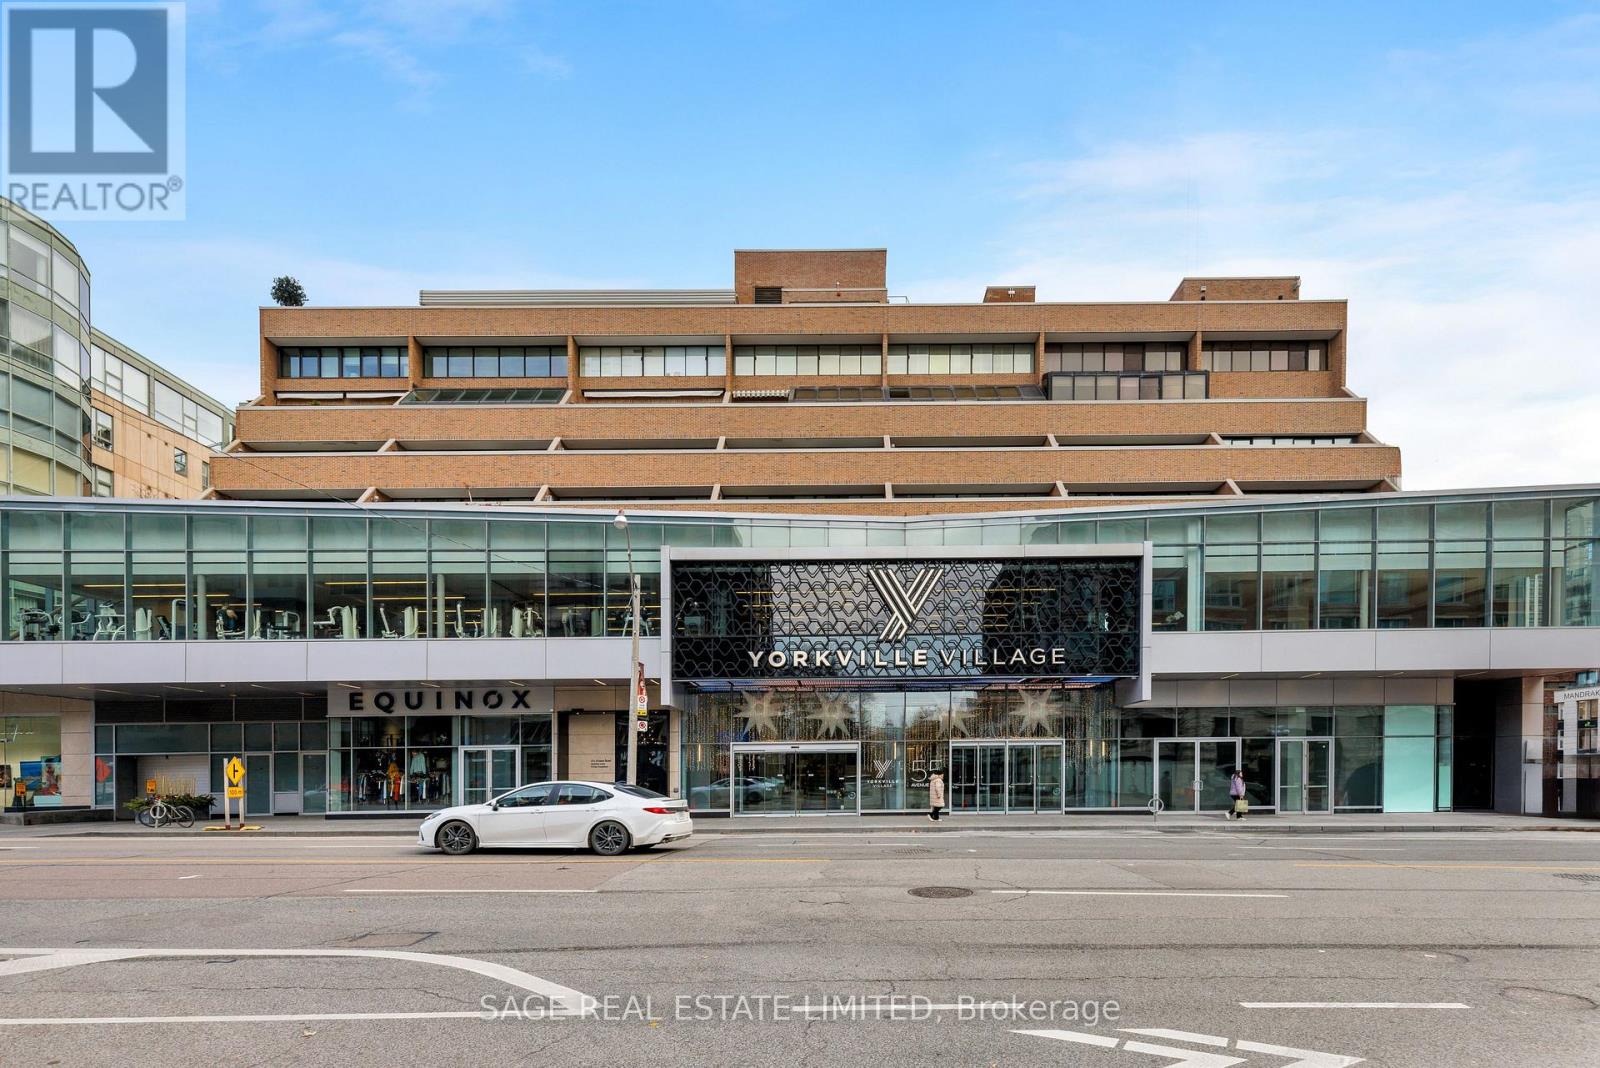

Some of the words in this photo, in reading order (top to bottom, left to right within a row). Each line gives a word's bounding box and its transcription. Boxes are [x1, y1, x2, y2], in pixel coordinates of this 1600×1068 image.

[748, 649, 928, 668] YORKVILLE
[942, 648, 1066, 666] VILLAGE
[349, 690, 530, 713] EQUINOX
